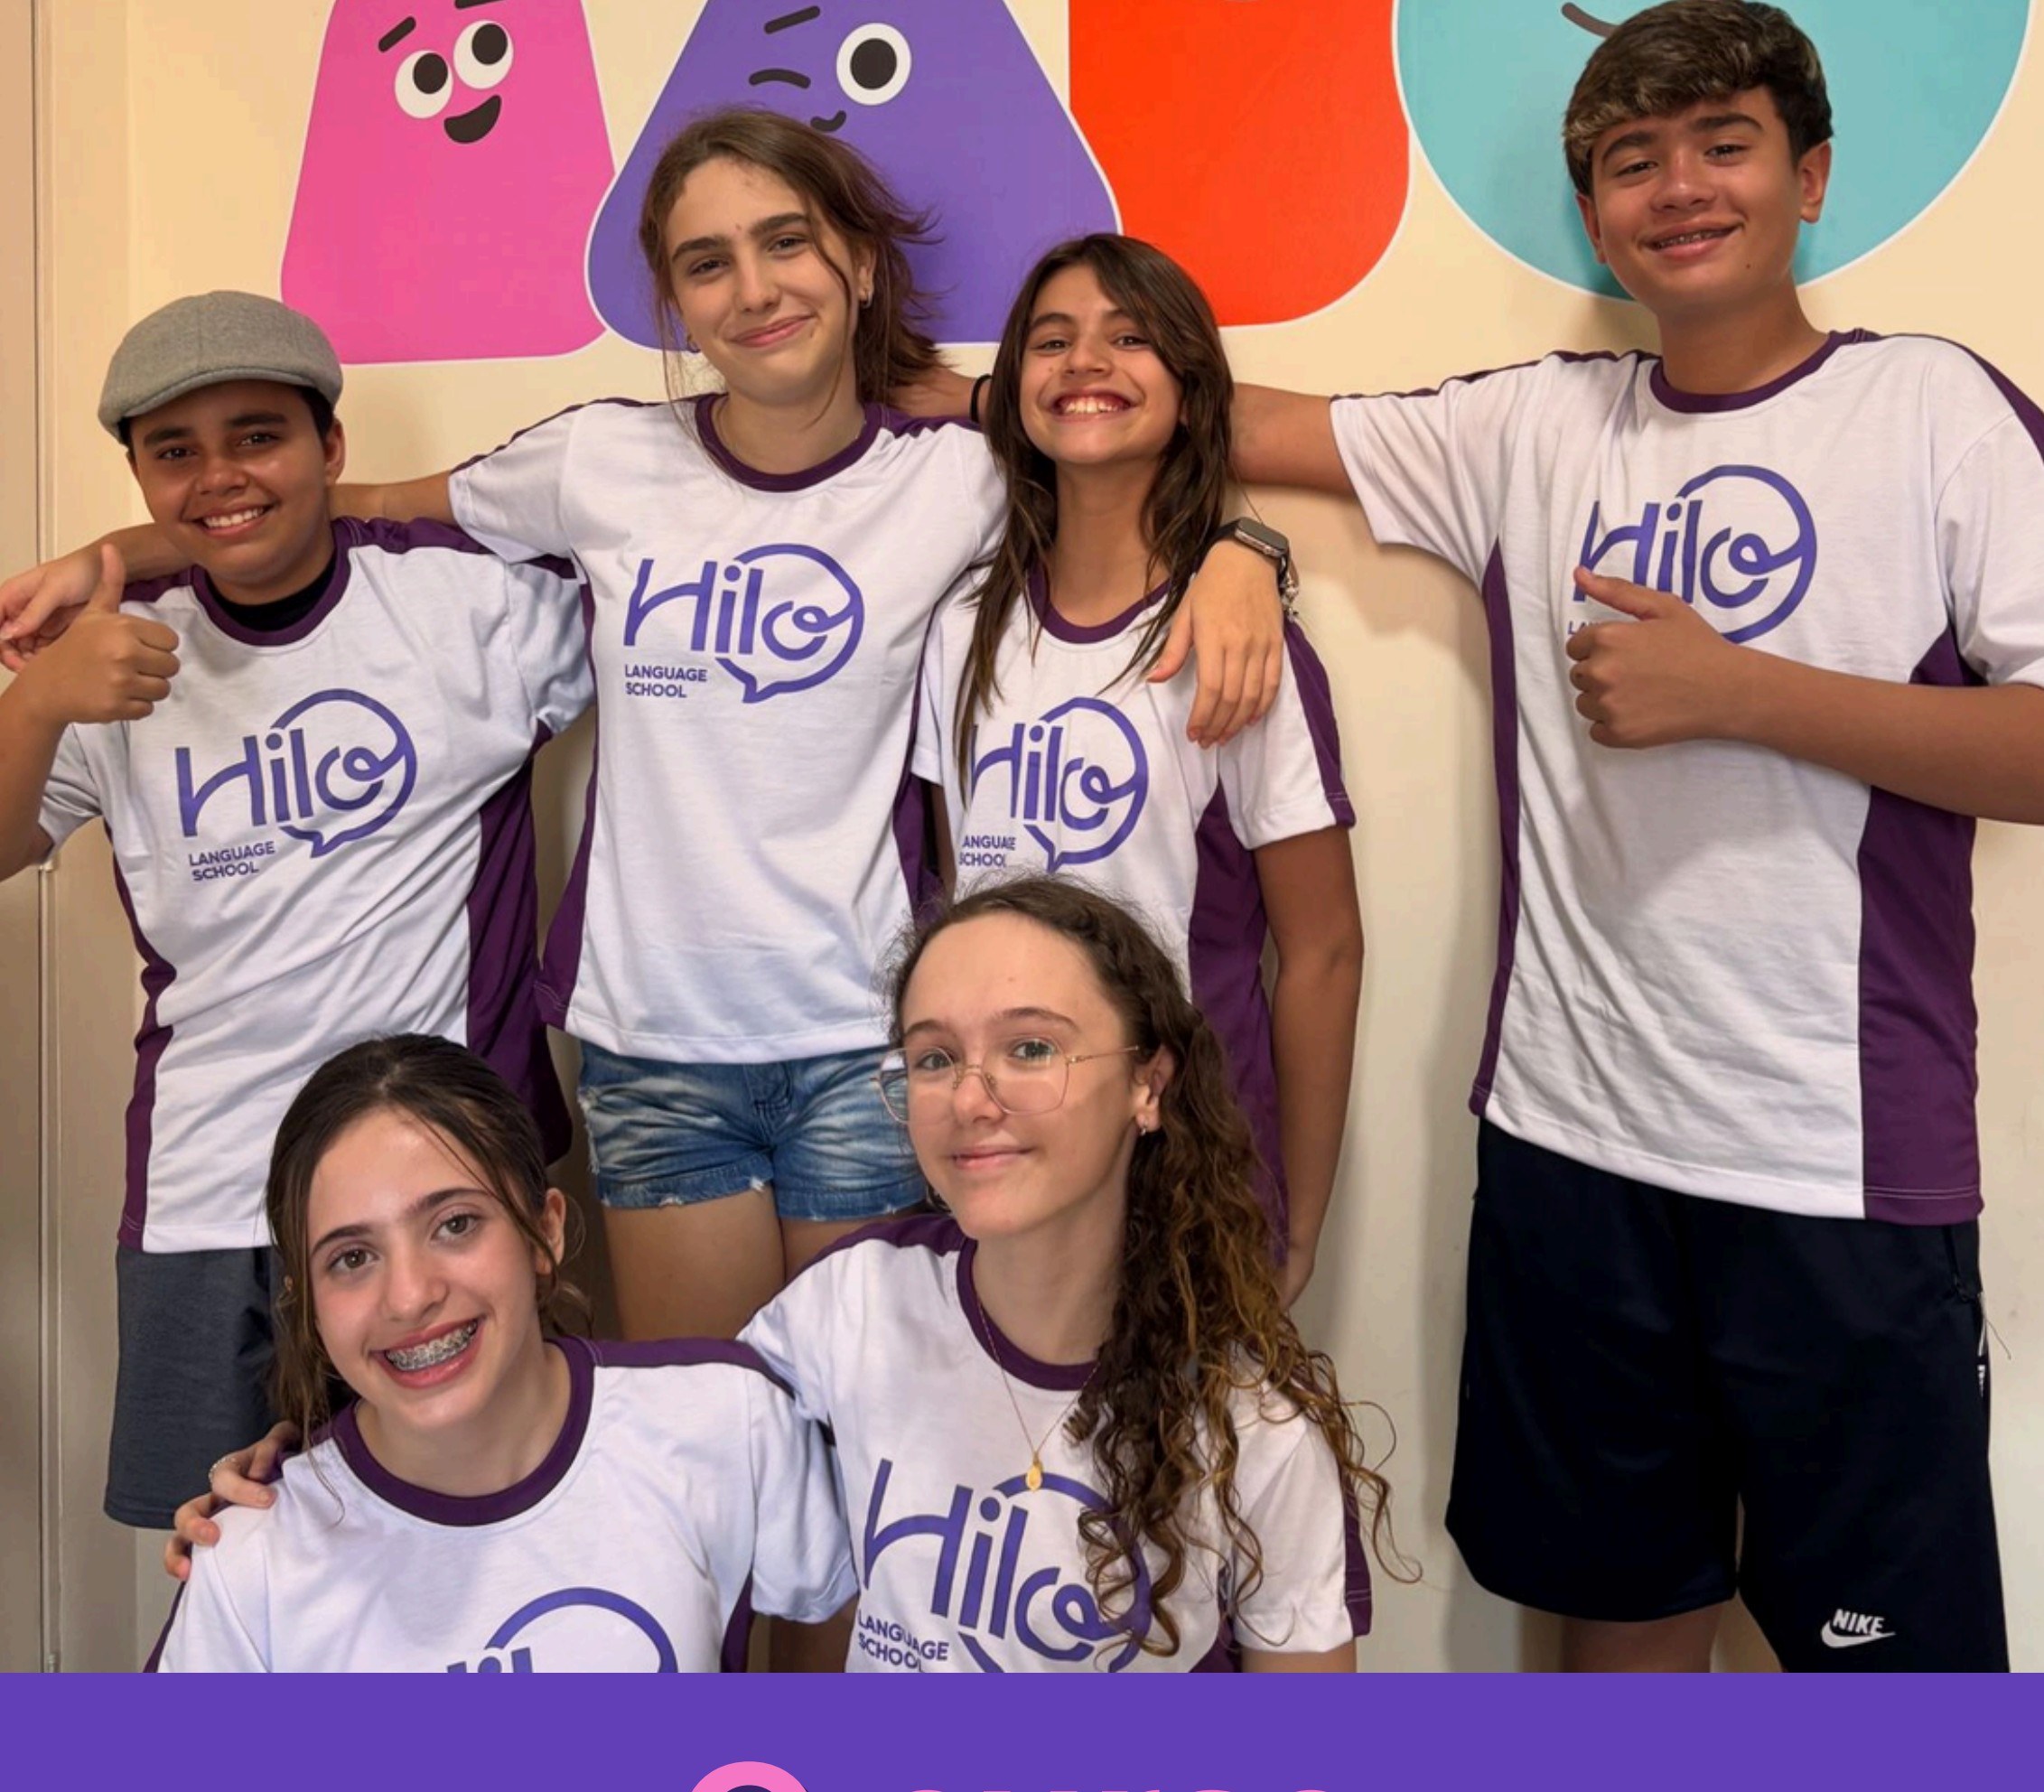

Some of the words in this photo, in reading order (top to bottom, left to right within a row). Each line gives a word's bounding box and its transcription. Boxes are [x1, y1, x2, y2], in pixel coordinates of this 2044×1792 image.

[624, 664, 708, 683] LANGUAGE
[624, 682, 688, 698] SCHOOL
[188, 840, 275, 866] LANGUAGE
[191, 861, 260, 882] SCHOOL
[1832, 1608, 1885, 1637] NIKE
[858, 1609, 950, 1661] LANGUAGE
